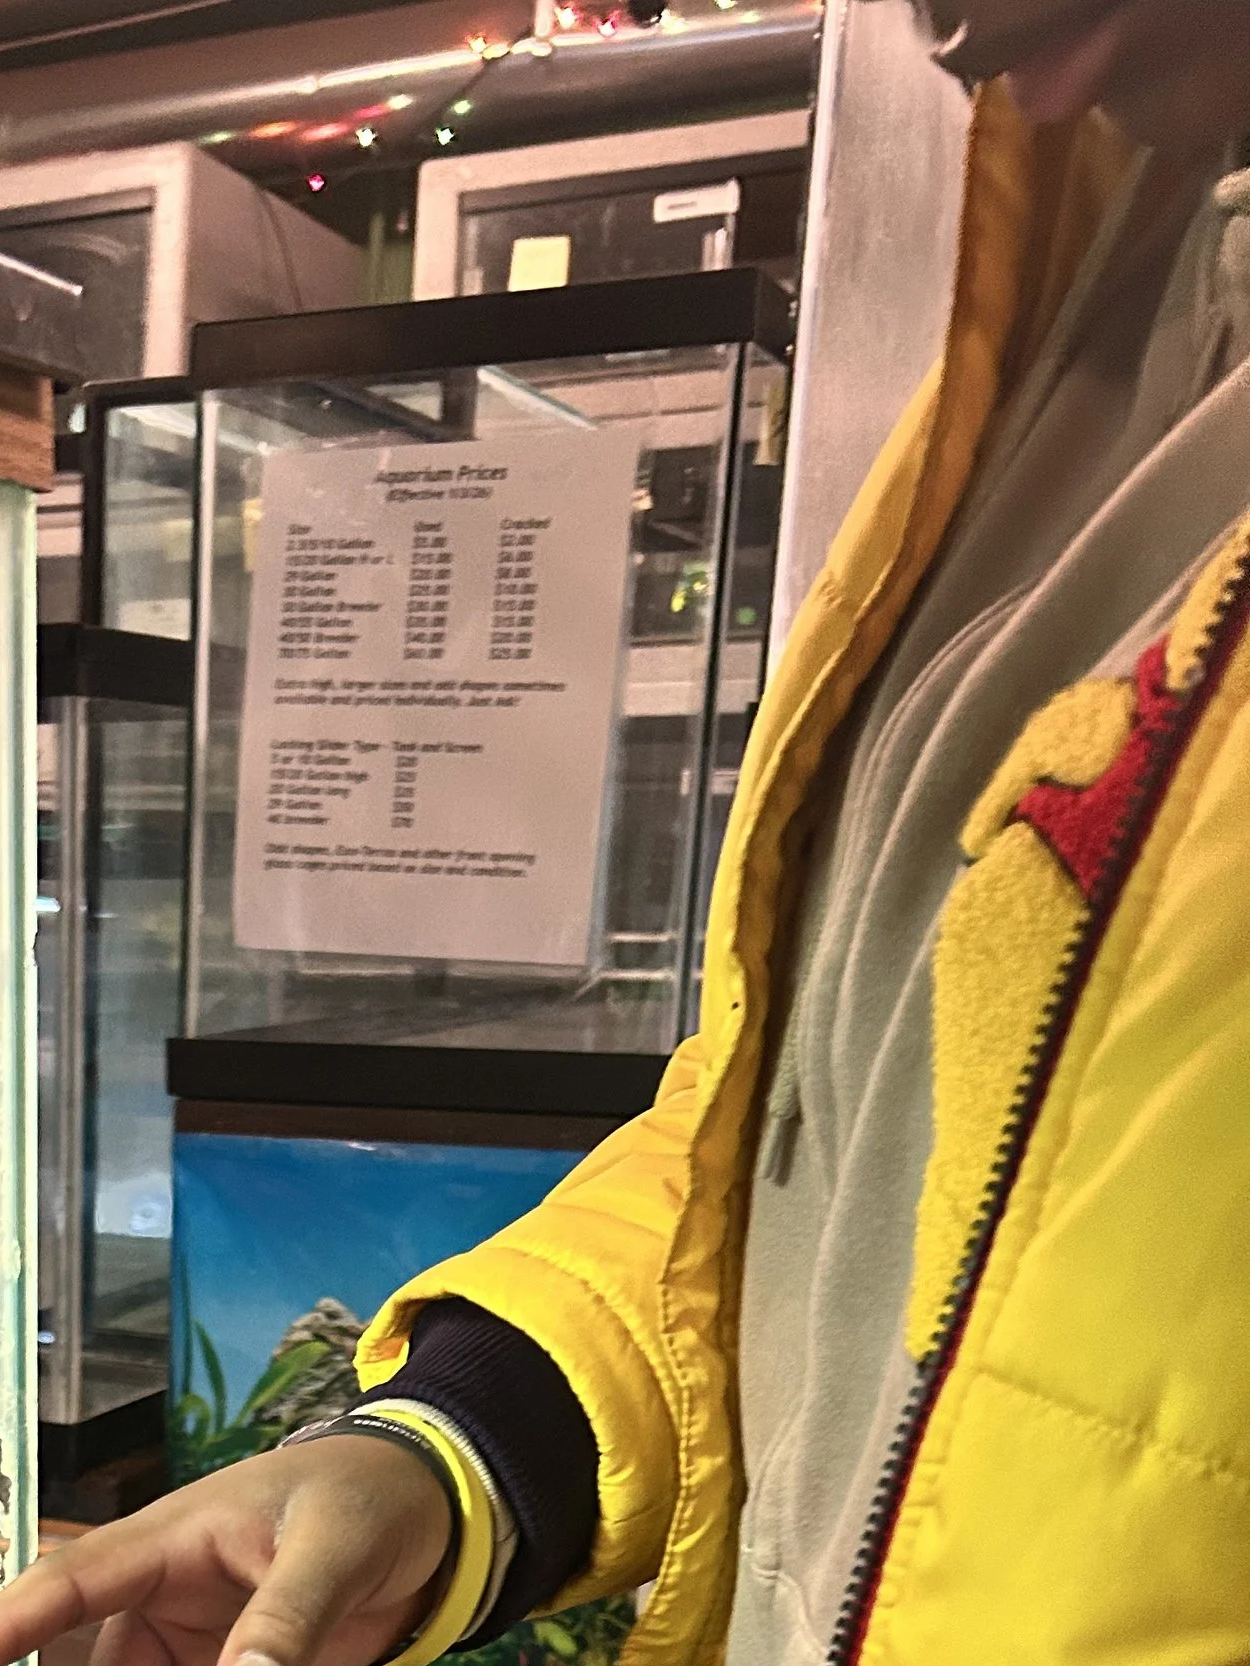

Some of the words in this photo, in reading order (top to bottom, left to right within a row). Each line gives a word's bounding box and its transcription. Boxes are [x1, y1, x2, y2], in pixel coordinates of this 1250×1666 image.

[373, 467, 453, 487] Aquarium
[457, 464, 508, 483] Prices
[500, 517, 552, 531] Cracked
[337, 539, 375, 550] Gallon
[319, 554, 356, 566] Gallon
[300, 570, 338, 582] Gallon
[299, 585, 336, 597] Gallon
[298, 601, 334, 612] Gallon
[314, 616, 353, 628] Gallon
[313, 647, 352, 659] Gallon
[411, 679, 432, 691] and
[459, 680, 501, 694] shapes
[503, 681, 566, 692] sometimes
[274, 695, 328, 705] available
[330, 695, 351, 705] and
[353, 695, 391, 707] priced
[352, 740, 380, 753] Type
[391, 741, 418, 753] Tank
[419, 743, 444, 753] and
[445, 741, 485, 753] Screen
[314, 754, 351, 765] Gallon
[306, 769, 342, 780] Gallon
[286, 784, 323, 796] Gallon
[285, 798, 323, 810] Gallon
[399, 848, 421, 859] and
[422, 848, 452, 860] other
[454, 849, 488, 862] front
[490, 852, 536, 867] opening
[263, 859, 293, 871] glass
[328, 861, 365, 873] priced
[367, 862, 401, 873] based
[403, 864, 416, 873] on
[444, 865, 467, 876] and
